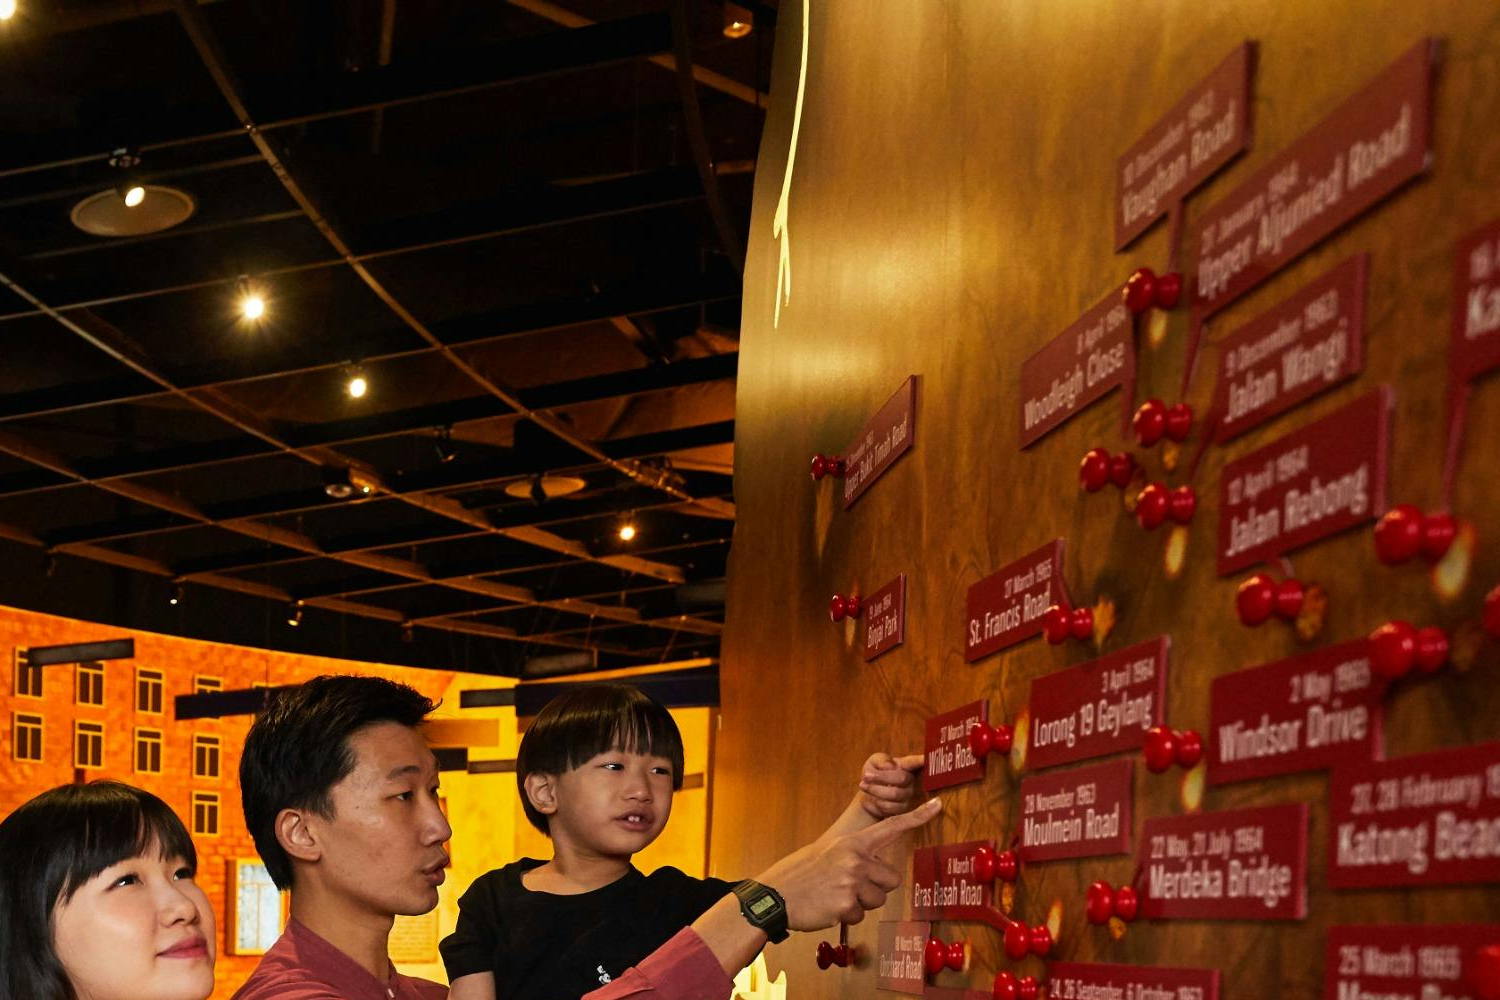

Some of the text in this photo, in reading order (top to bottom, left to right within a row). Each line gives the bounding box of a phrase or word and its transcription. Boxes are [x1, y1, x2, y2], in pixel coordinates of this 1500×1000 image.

[1190, 99, 1235, 169] Road
[1198, 103, 1410, 300] Upper Aljunied Road
[1025, 342, 1124, 431] Woodleigh Close
[1223, 317, 1348, 423] Jalan Wangi
[860, 453, 873, 482] Bukit
[875, 431, 891, 467] Timah
[892, 412, 908, 449] Road
[1243, 460, 1274, 501] April
[1225, 461, 1368, 557] Jalan Rebong
[1013, 567, 1035, 594] March
[885, 608, 898, 638] Park
[969, 581, 1051, 647] St. Francis Road
[1109, 662, 1132, 695] April
[947, 720, 964, 741] March
[1033, 690, 1153, 748] Lorong 19 Geylang
[1219, 698, 1367, 764] Windsor Drive
[928, 744, 953, 777] Wilkie
[1036, 787, 1075, 812] November
[1400, 773, 1483, 809] February
[1023, 801, 1120, 847] Moulmein Road
[1206, 828, 1233, 860] July
[952, 855, 970, 874] March
[1336, 822, 1429, 875] Katong
[914, 878, 983, 907] Bras Basah Road
[1148, 853, 1291, 908] Merdeka Bridge
[880, 951, 922, 979] Orchard Road
[1362, 945, 1414, 977] March
